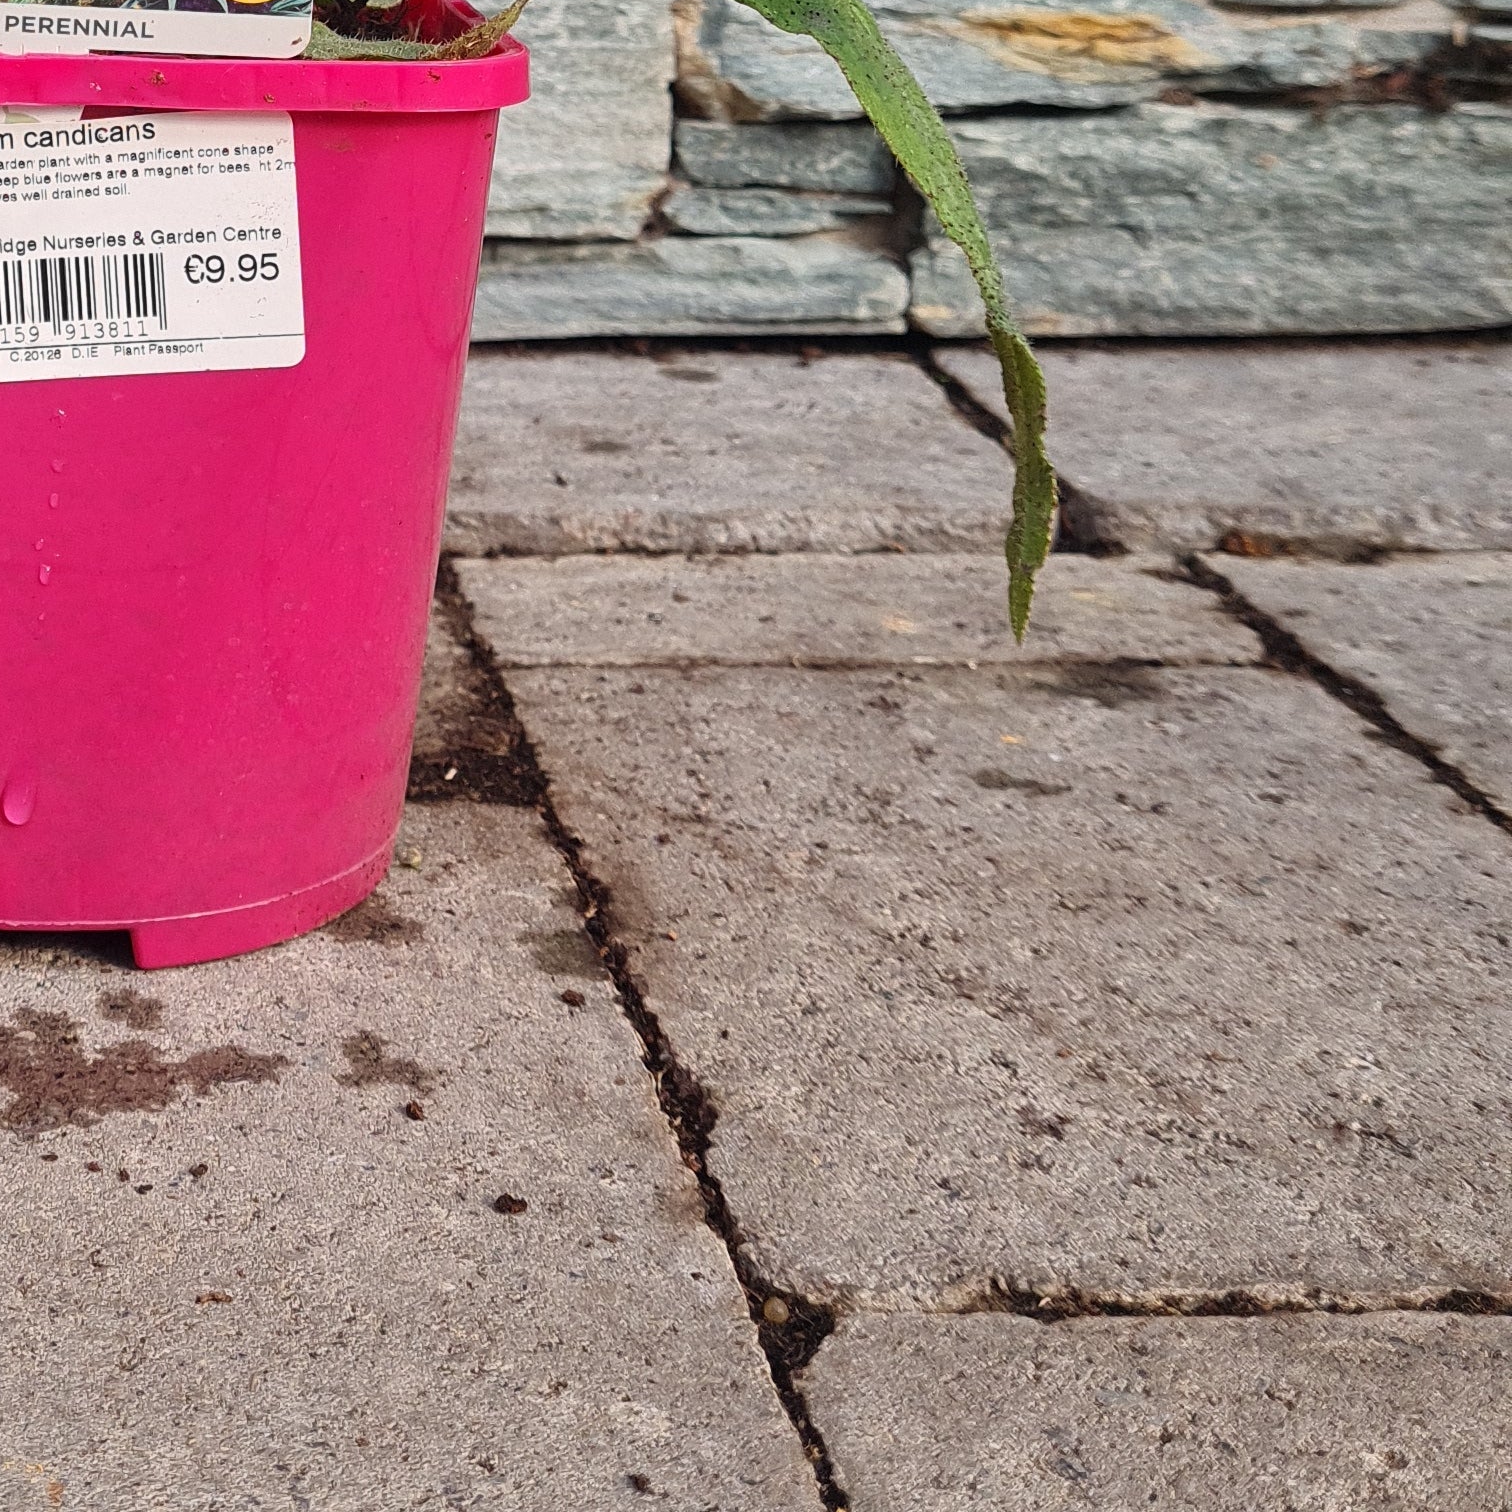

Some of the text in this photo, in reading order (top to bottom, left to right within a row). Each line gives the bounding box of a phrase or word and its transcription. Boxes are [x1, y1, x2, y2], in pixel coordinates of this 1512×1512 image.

[4, 15, 154, 39] PERENNIAL
[24, 122, 153, 148] candicans
[39, 156, 71, 169] plant
[73, 153, 100, 165] with
[105, 154, 113, 163] a
[118, 147, 194, 163] magnificent
[198, 147, 230, 158] cone
[234, 144, 274, 158] shape
[24, 173, 51, 185] blue
[55, 170, 102, 184] flowers
[107, 168, 128, 179] are
[131, 168, 139, 177] a
[144, 164, 194, 179] magnet
[197, 162, 215, 174] for
[219, 161, 250, 173] bees
[259, 160, 272, 172] ht
[21, 189, 47, 201] well
[52, 185, 100, 200] drained
[105, 182, 130, 195] soil.
[43, 232, 126, 251] Nurseries
[133, 230, 145, 246] &
[151, 228, 216, 245] Garden
[223, 226, 281, 241] Centre
[184, 253, 279, 284] €9.95
[65, 320, 148, 340] 913811
[114, 346, 146, 356] Plant
[149, 343, 204, 357] Passport
